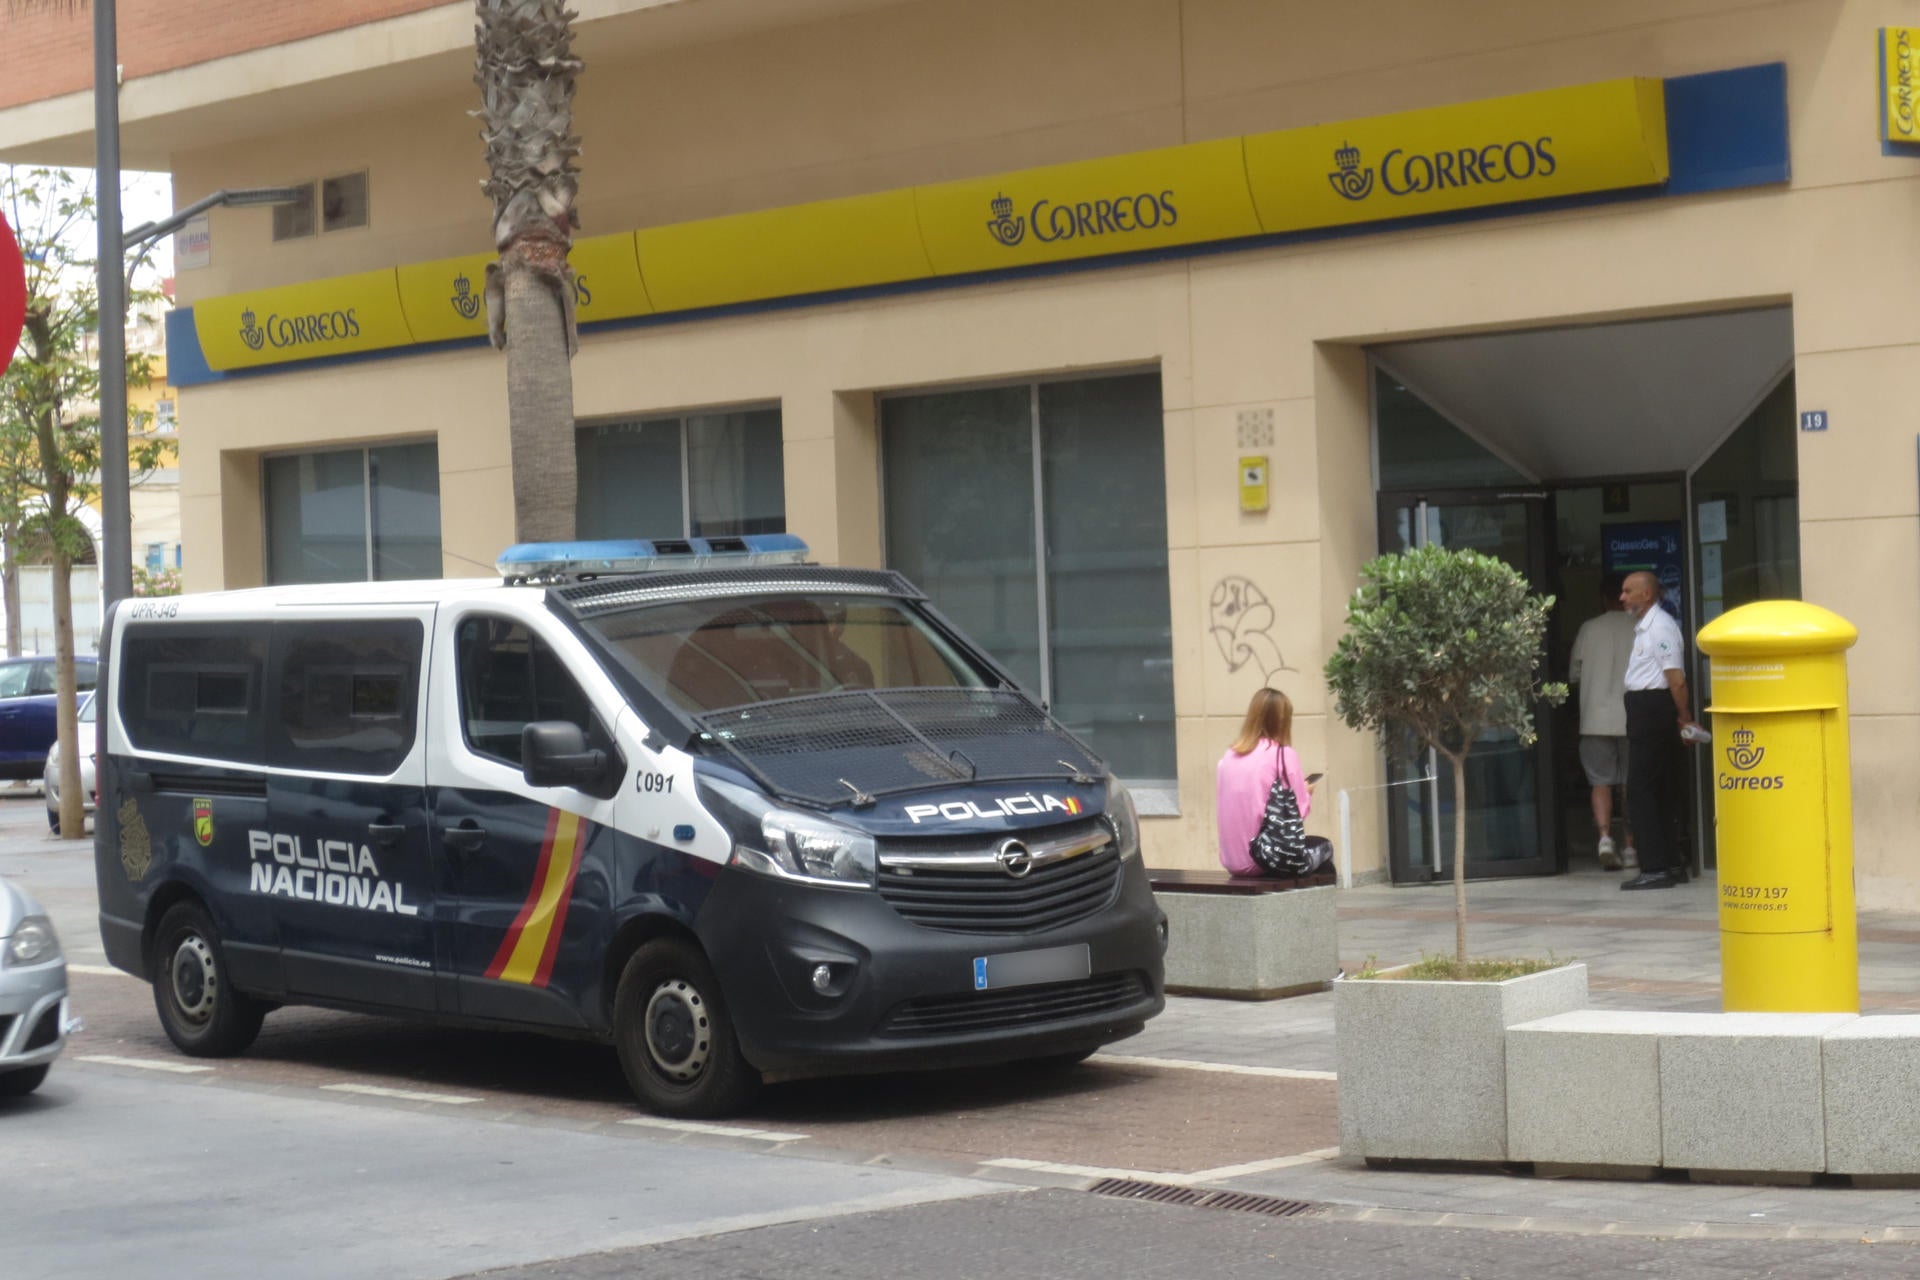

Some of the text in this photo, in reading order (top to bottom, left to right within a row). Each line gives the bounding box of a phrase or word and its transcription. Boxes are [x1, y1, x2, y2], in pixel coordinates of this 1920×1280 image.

[1896, 28, 1913, 136] CORREOS
[1380, 136, 1556, 196] CORREOS
[1030, 189, 1177, 243] CORREOS
[266, 307, 360, 348] CORREOS
[1806, 413, 1822, 428] 19
[644, 772, 675, 794] 091
[1719, 772, 1784, 790] Correos
[248, 829, 379, 877] POLICIA
[250, 861, 418, 916] NACIONAL
[1723, 902, 1788, 911] www.correos.es
[1740, 887, 1761, 899] 197
[1764, 887, 1788, 899] 197
